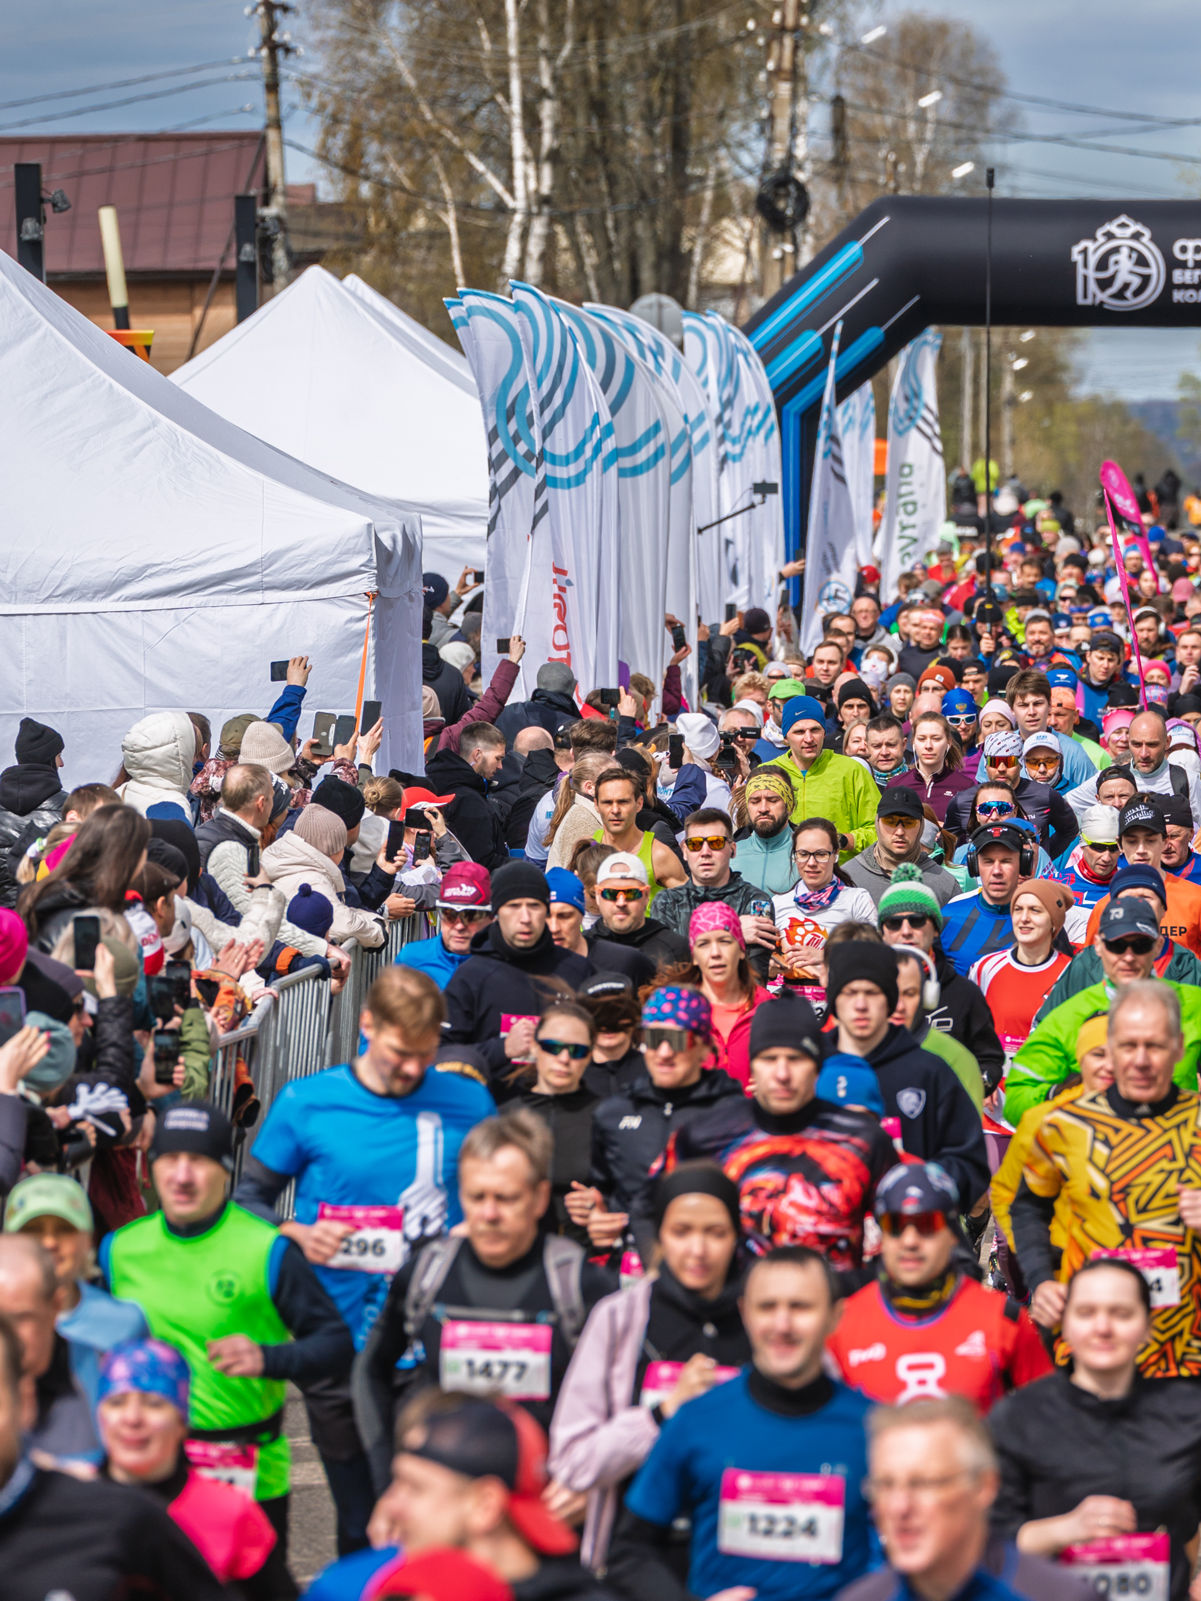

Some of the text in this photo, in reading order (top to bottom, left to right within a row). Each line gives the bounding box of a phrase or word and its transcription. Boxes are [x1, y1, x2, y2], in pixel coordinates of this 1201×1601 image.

[341, 1237, 386, 1257] 296
[465, 1358, 529, 1382] 1477
[747, 1513, 818, 1538] 1224
[1094, 1572, 1152, 1596] 080
